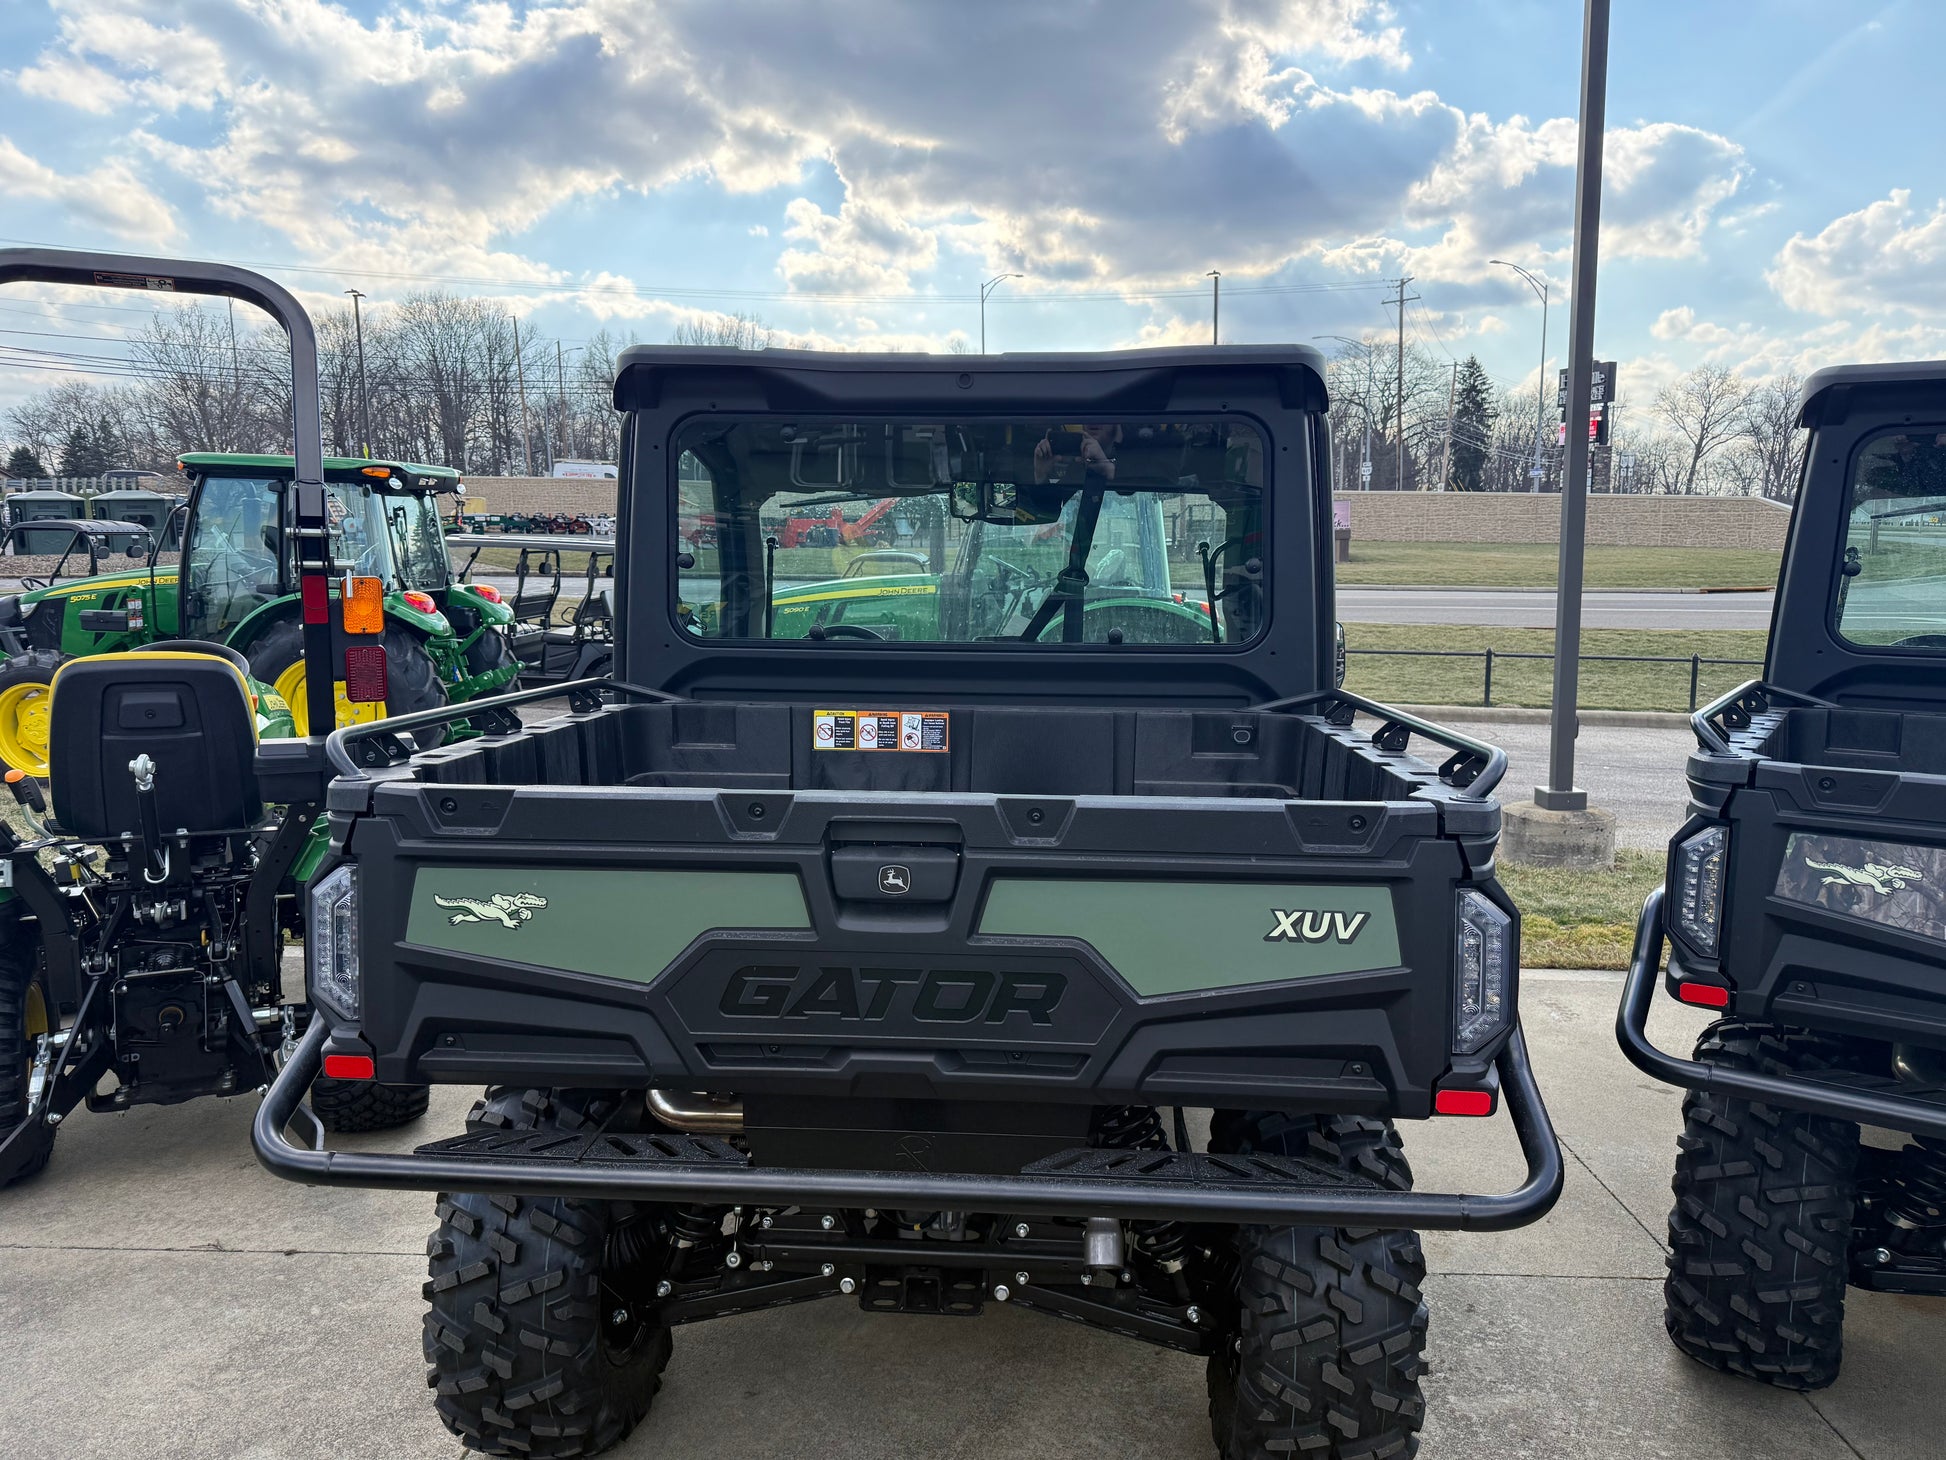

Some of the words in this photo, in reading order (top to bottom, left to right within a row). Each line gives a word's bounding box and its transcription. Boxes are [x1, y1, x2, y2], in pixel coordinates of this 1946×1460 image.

[880, 588, 900, 596] JOHN
[1265, 909, 1369, 943] XUV
[718, 965, 1069, 1026] GATOR
